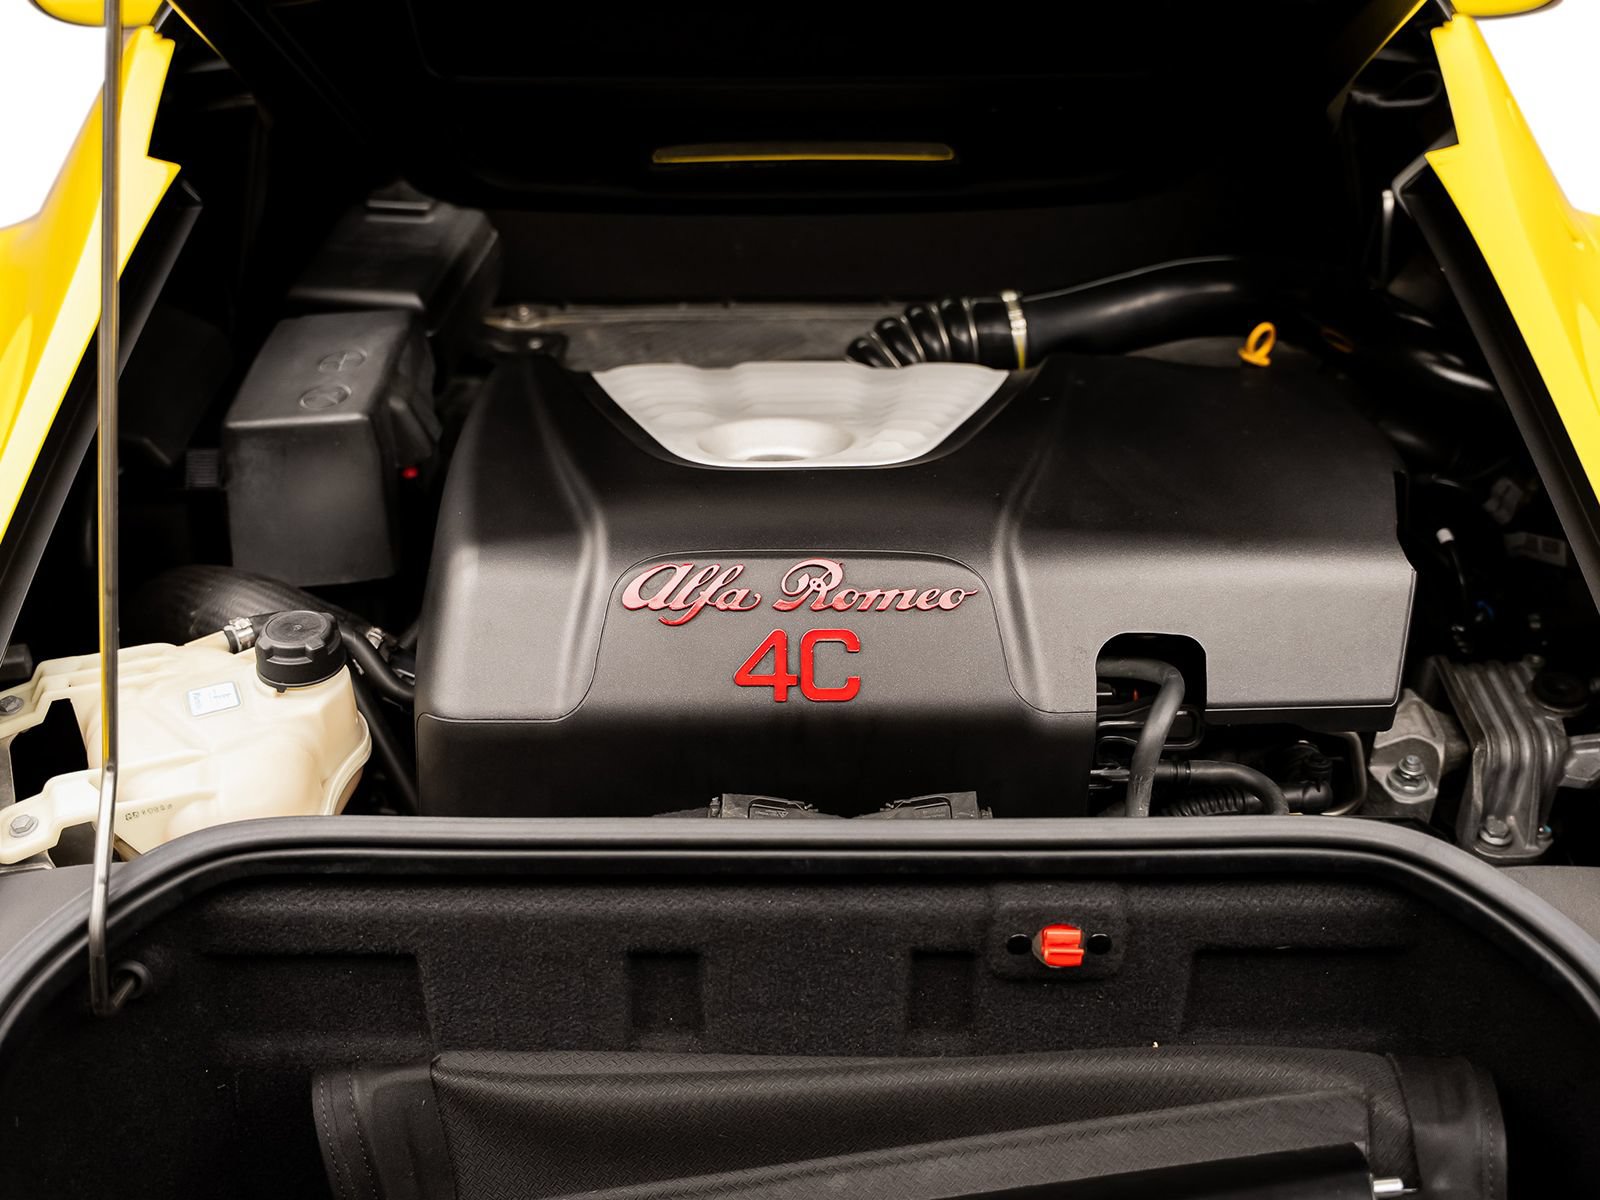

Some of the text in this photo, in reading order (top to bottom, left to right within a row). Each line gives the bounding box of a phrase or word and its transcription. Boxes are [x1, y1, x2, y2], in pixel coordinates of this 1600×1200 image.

[622, 557, 979, 627] Alfa Romeo
[733, 628, 861, 703] 4C
